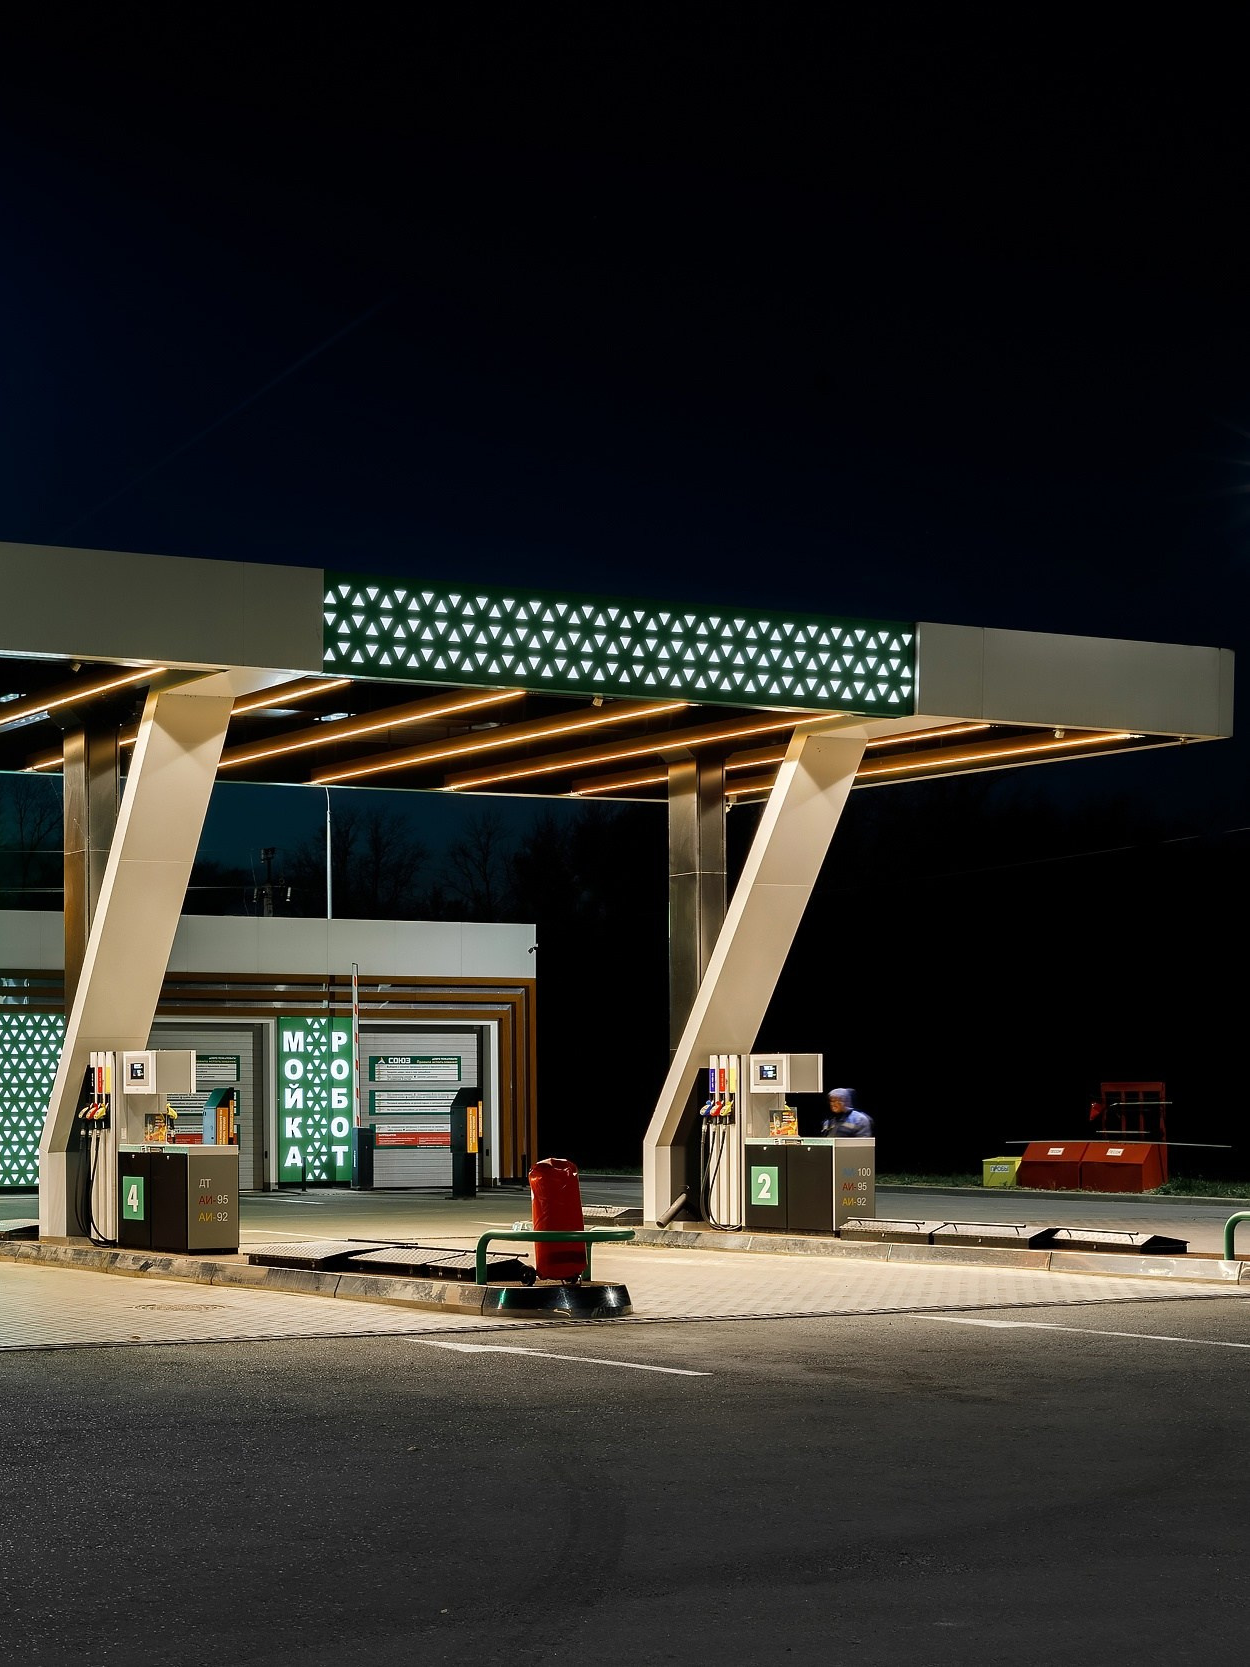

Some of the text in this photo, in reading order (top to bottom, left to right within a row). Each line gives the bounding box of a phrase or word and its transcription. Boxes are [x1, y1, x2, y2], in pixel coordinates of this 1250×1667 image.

[283, 1031, 306, 1168] МОЙКА
[330, 1031, 350, 1167] РОБОТ
[199, 1178, 211, 1188] ДТ
[757, 1172, 771, 1199] 2
[842, 1182, 867, 1191] АИ-95
[127, 1184, 139, 1212] 4
[199, 1195, 229, 1205] АИ-95
[842, 1197, 867, 1206] АИ-92
[198, 1212, 228, 1222] АИ-92
